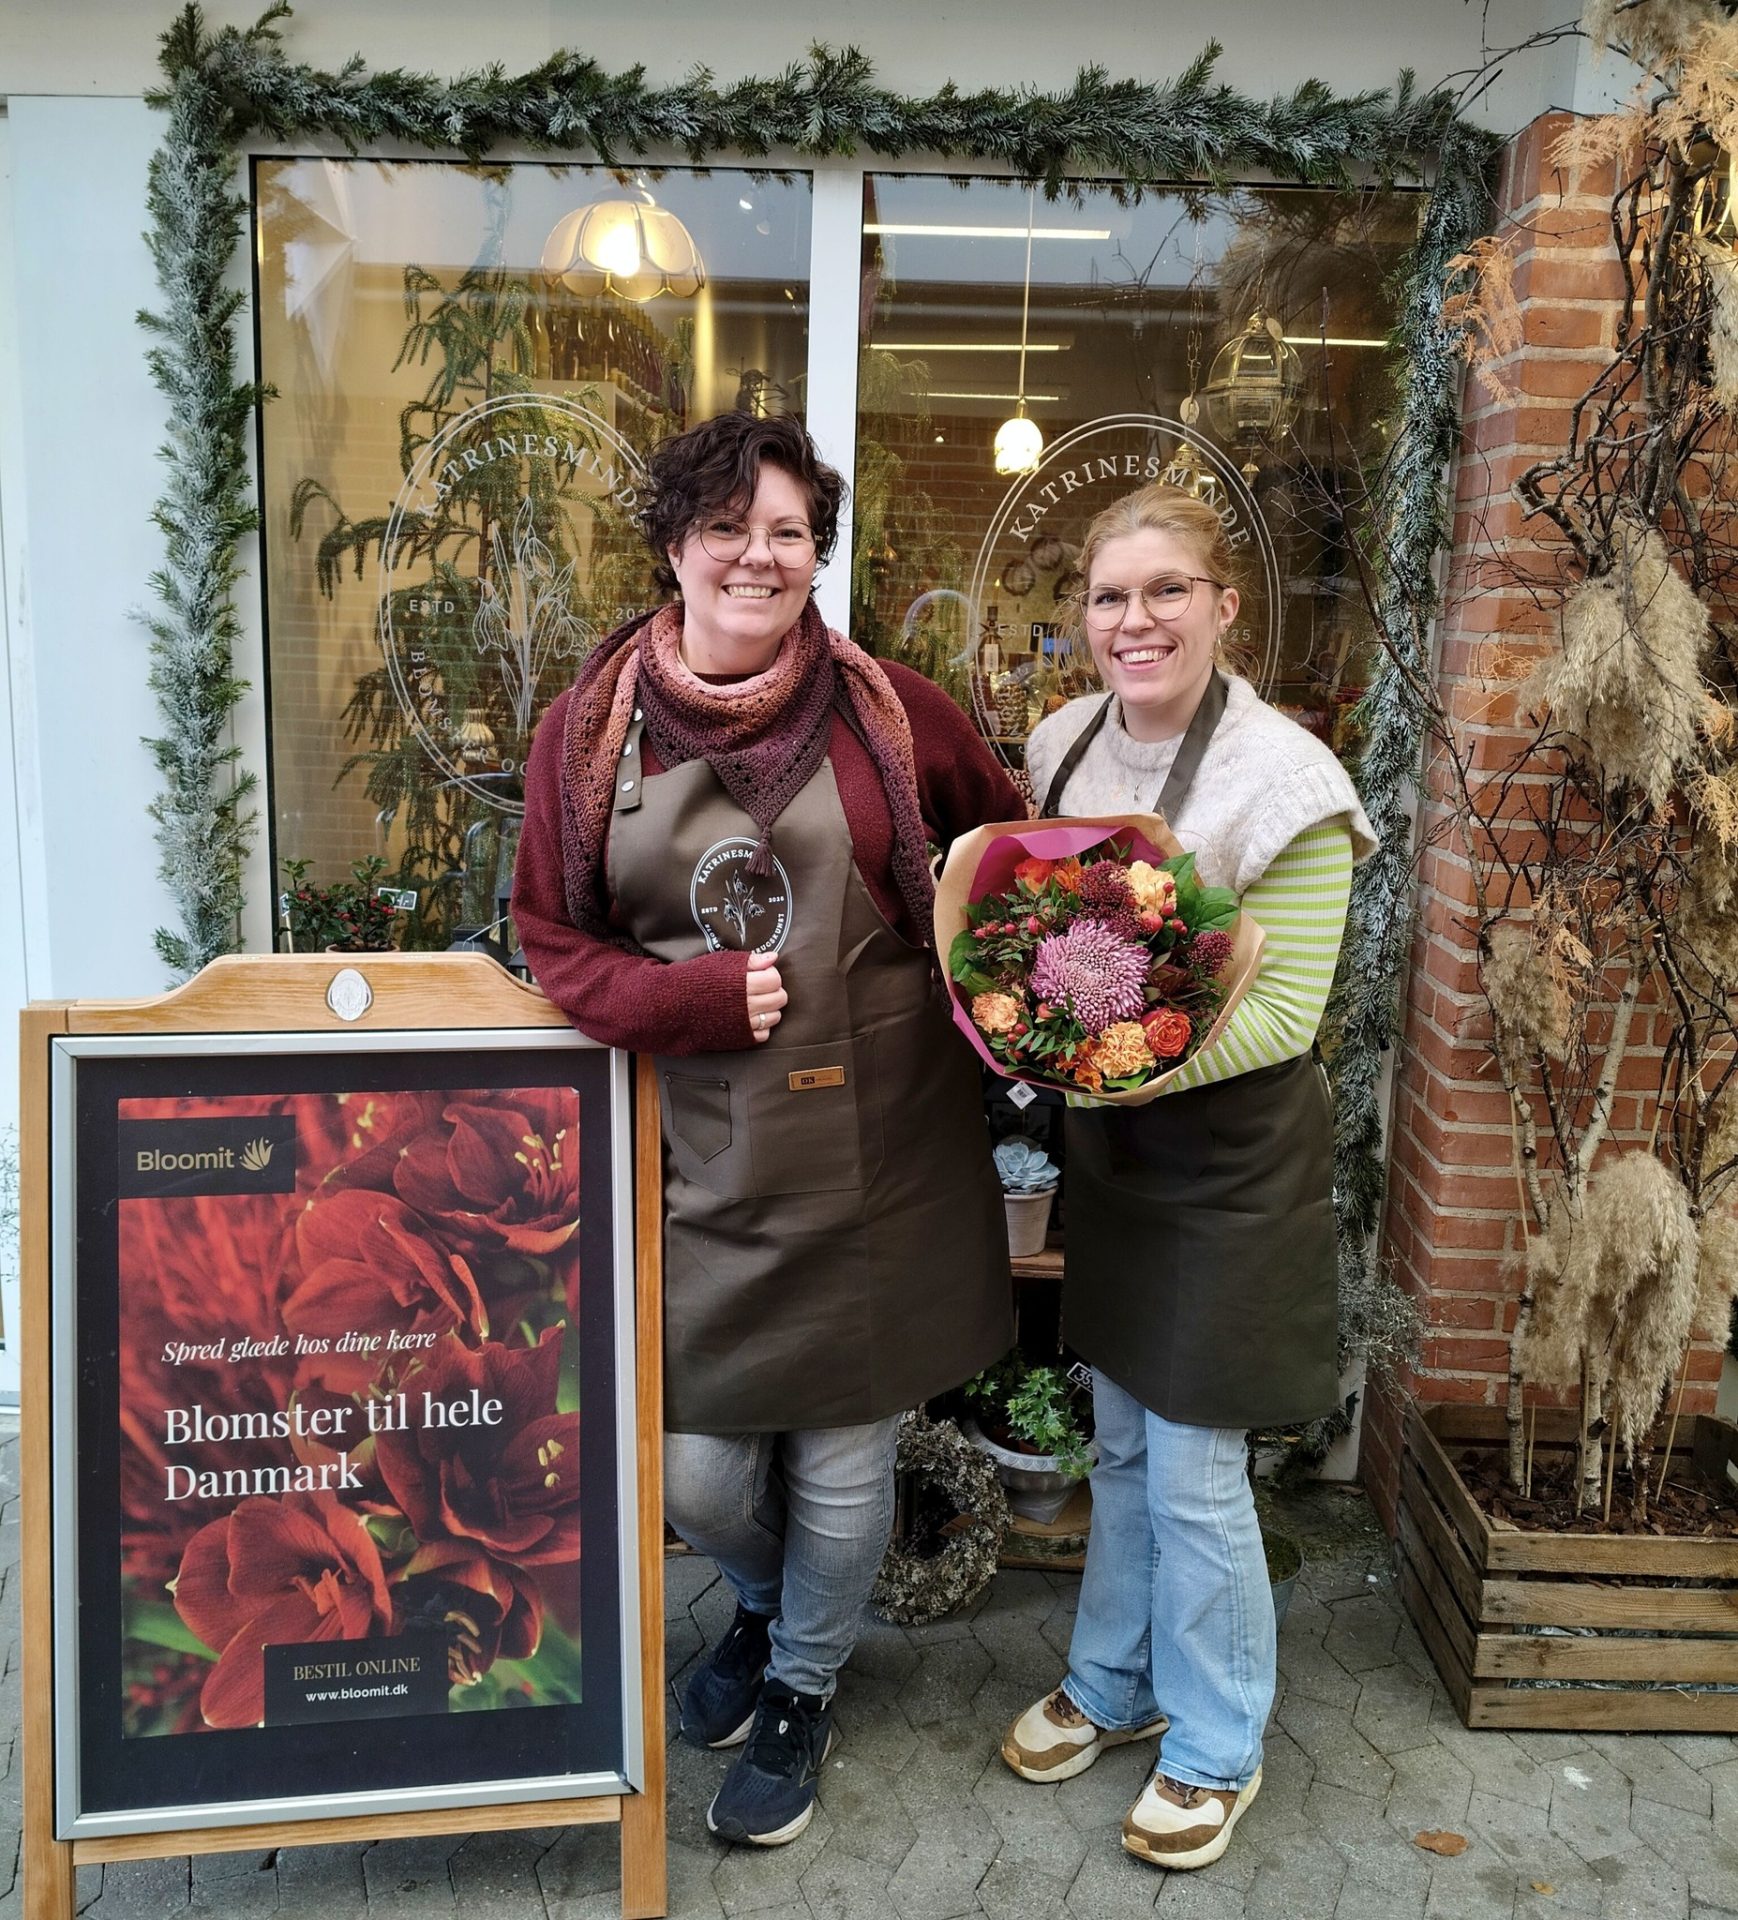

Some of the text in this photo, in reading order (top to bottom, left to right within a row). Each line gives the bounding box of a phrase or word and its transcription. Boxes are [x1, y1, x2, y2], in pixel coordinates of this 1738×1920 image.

[1009, 455, 1250, 549] KATRINESMNDE
[410, 600, 455, 613] ESTD
[616, 608, 647, 620] 202
[997, 624, 1043, 637] ESTD
[1231, 629, 1251, 641] 25
[698, 849, 754, 884] KATRINESM
[137, 1147, 235, 1171] Bloomit
[161, 1329, 436, 1365] Spred glæde hos dine kære
[164, 1389, 503, 1445] Blomster til hele
[164, 1452, 364, 1501] Danmark
[294, 1657, 420, 1680] BESTIL ONLINE
[305, 1684, 408, 1702] www.bloomit.dk
